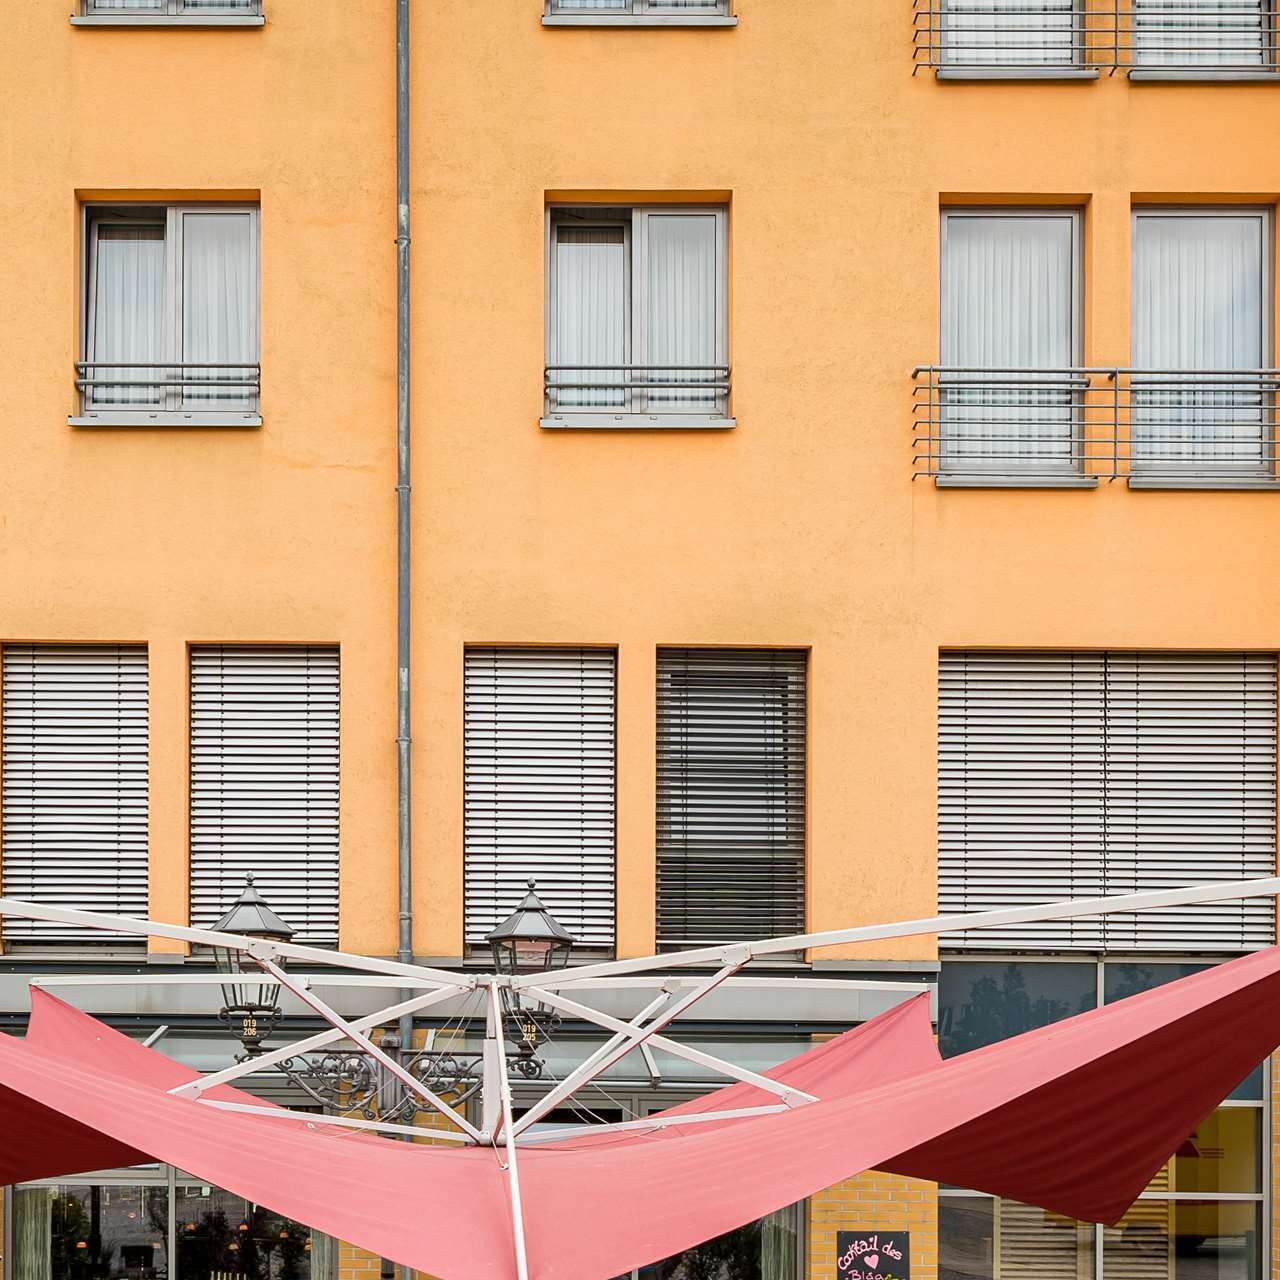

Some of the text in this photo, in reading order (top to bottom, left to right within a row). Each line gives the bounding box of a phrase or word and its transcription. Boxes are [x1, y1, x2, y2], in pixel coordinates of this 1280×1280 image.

[243, 1019, 257, 1027] 019
[243, 1028, 257, 1036] 206
[522, 1025, 536, 1033] 019
[882, 1240, 903, 1261] des
